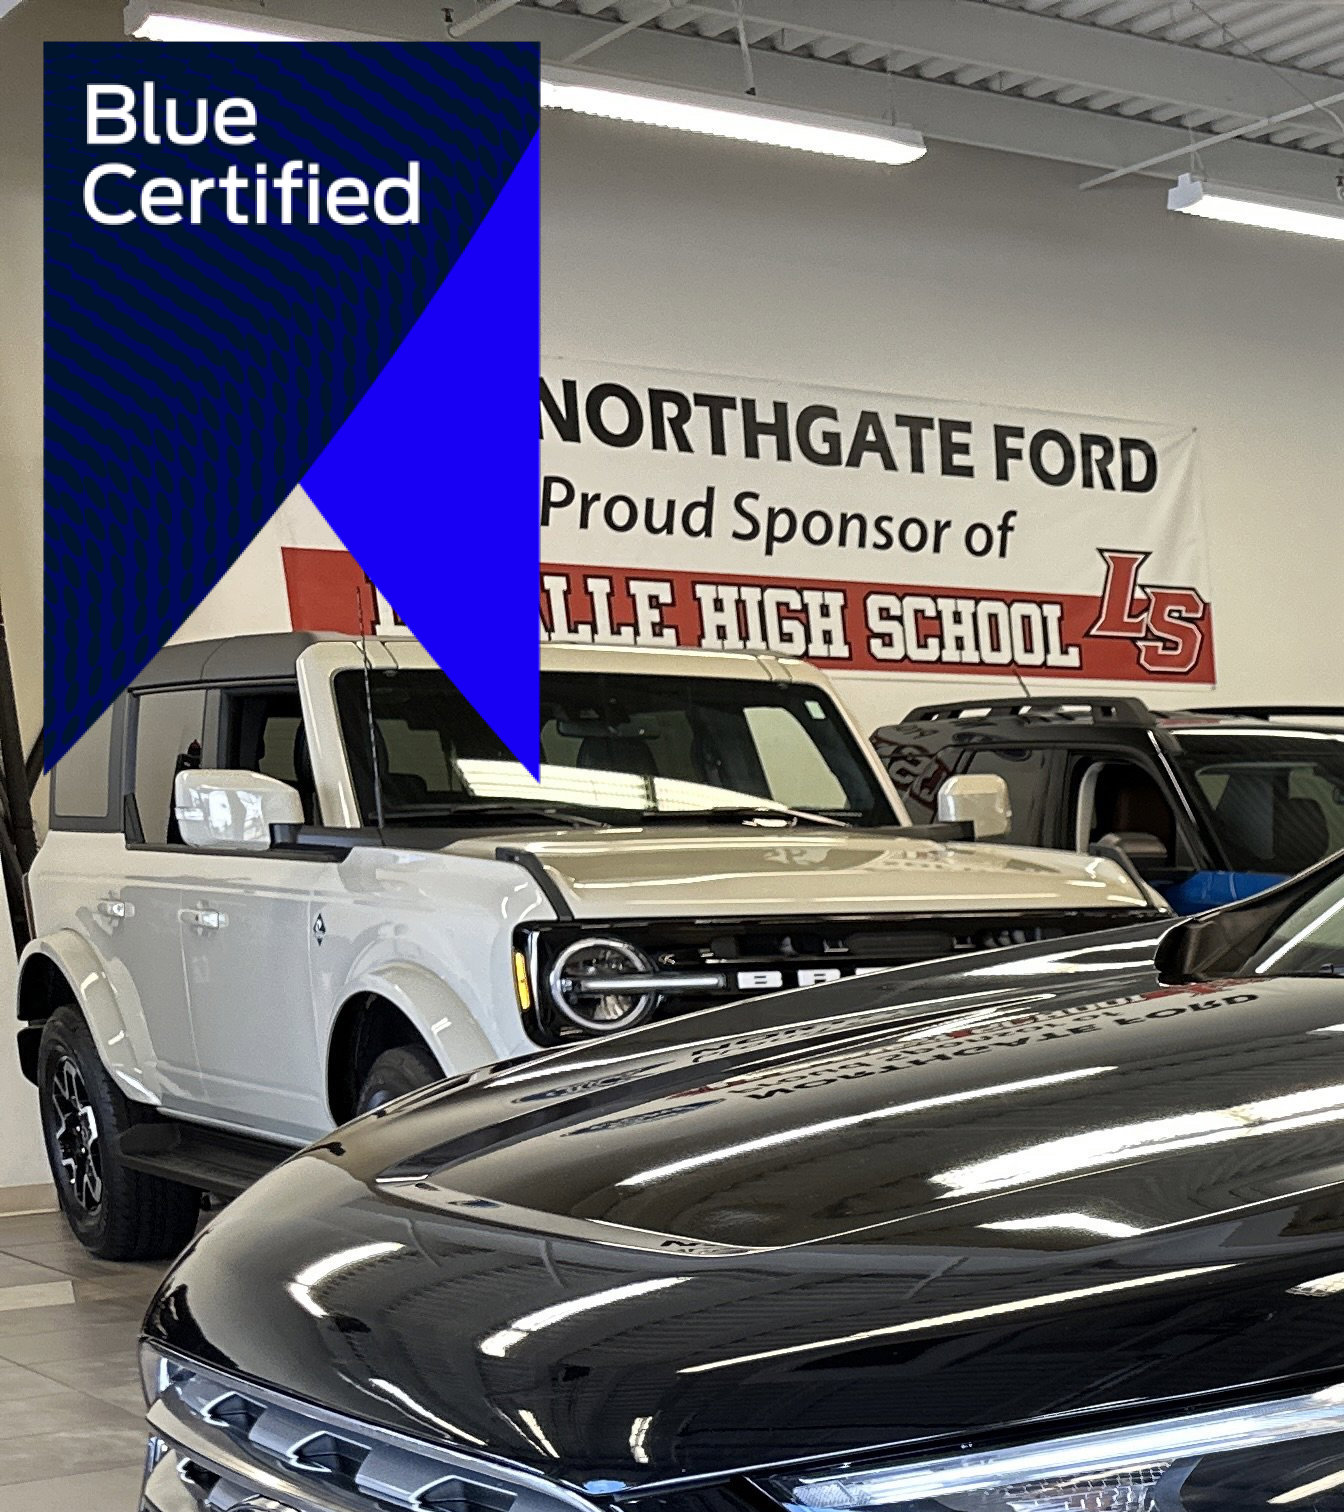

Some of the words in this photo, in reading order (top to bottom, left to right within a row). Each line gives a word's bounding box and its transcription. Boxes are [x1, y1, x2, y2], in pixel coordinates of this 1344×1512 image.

[539, 377, 976, 479] NORTHGATE
[992, 422, 1159, 494] FORD
[540, 475, 716, 539] Proud
[731, 490, 953, 557] Sponsor
[964, 509, 1018, 559] of
[693, 580, 850, 660] HIGH
[866, 592, 1083, 670] SCHOOL
[1084, 547, 1211, 675] LS
